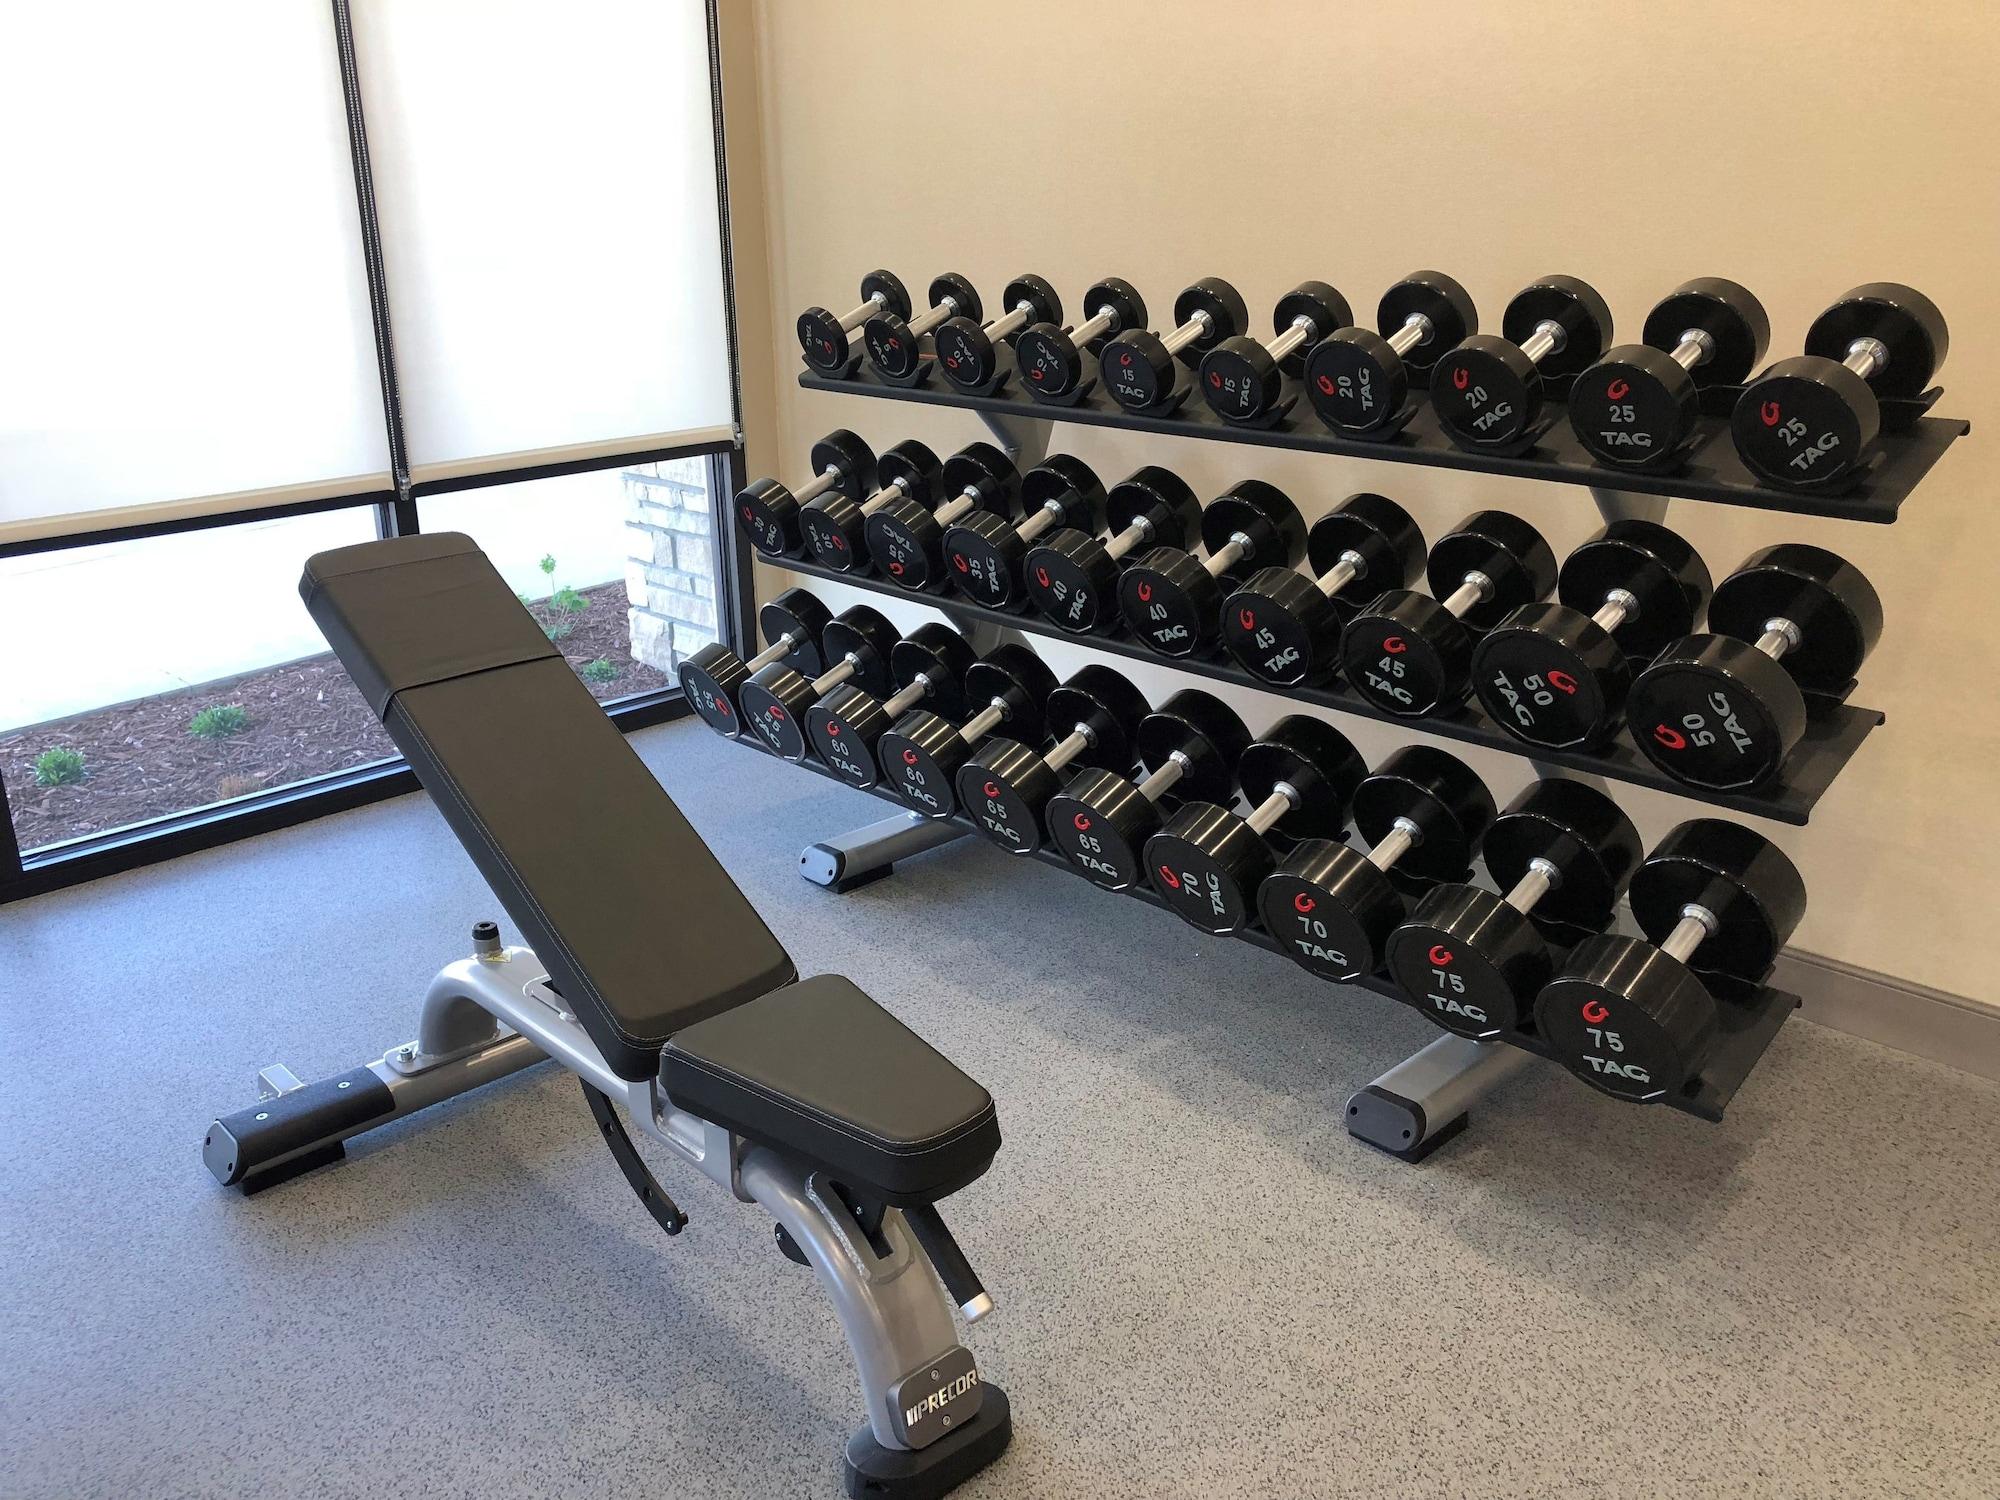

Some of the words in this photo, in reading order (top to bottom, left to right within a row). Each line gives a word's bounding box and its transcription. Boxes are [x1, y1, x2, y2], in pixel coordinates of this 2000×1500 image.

[872, 337, 889, 367] TAG
[955, 336, 976, 366] TAG
[1036, 341, 1060, 370] TAG
[1123, 369, 1134, 381] 15
[1225, 378, 1235, 392] 15
[1338, 376, 1353, 398] 20
[1117, 384, 1144, 398] TAG
[1240, 377, 1251, 407] TAG
[1359, 368, 1373, 410] TAG
[1465, 386, 1487, 409] 20
[1472, 401, 1512, 432] TAG
[1609, 405, 1635, 422] 25
[1600, 432, 1651, 447] TAG
[1778, 417, 1807, 446] 25
[1790, 432, 1840, 471] TAG
[766, 524, 777, 545] TAG
[809, 523, 823, 553] TAG
[882, 523, 913, 553] TAG
[889, 544, 904, 563] 35
[971, 558, 984, 579] 35
[989, 556, 999, 593] TAG
[1053, 581, 1067, 601] 40
[1069, 589, 1087, 620] TAG
[1150, 604, 1167, 620] 40
[1153, 625, 1187, 642] TAG
[1256, 627, 1275, 649] 45
[1265, 647, 1299, 672] TAG
[1379, 657, 1405, 678] 45
[688, 678, 704, 710] TAG
[1364, 671, 1413, 705] TAG
[1492, 670, 1535, 727] TAG
[1523, 674, 1553, 705] 50
[754, 712, 782, 749] TAG
[1683, 714, 1715, 746] 50
[1708, 691, 1753, 754] TAG
[832, 739, 848, 755] 60
[831, 756, 862, 777] TAG
[906, 767, 924, 785] 60
[903, 782, 937, 807] TAG
[986, 799, 1006, 820] 65
[983, 816, 1020, 842] TAG
[1079, 834, 1101, 853] 65
[1077, 853, 1117, 877] TAG
[1182, 872, 1201, 897] 70
[1206, 872, 1225, 915] TAG
[1298, 916, 1327, 938] 70
[1295, 940, 1347, 966] TAG
[1432, 969, 1464, 993] 75
[1427, 994, 1487, 1024] TAG
[1586, 1028, 1624, 1052] 75
[1583, 1055, 1650, 1083] TAG
[917, 1369, 978, 1419] PRECOR
